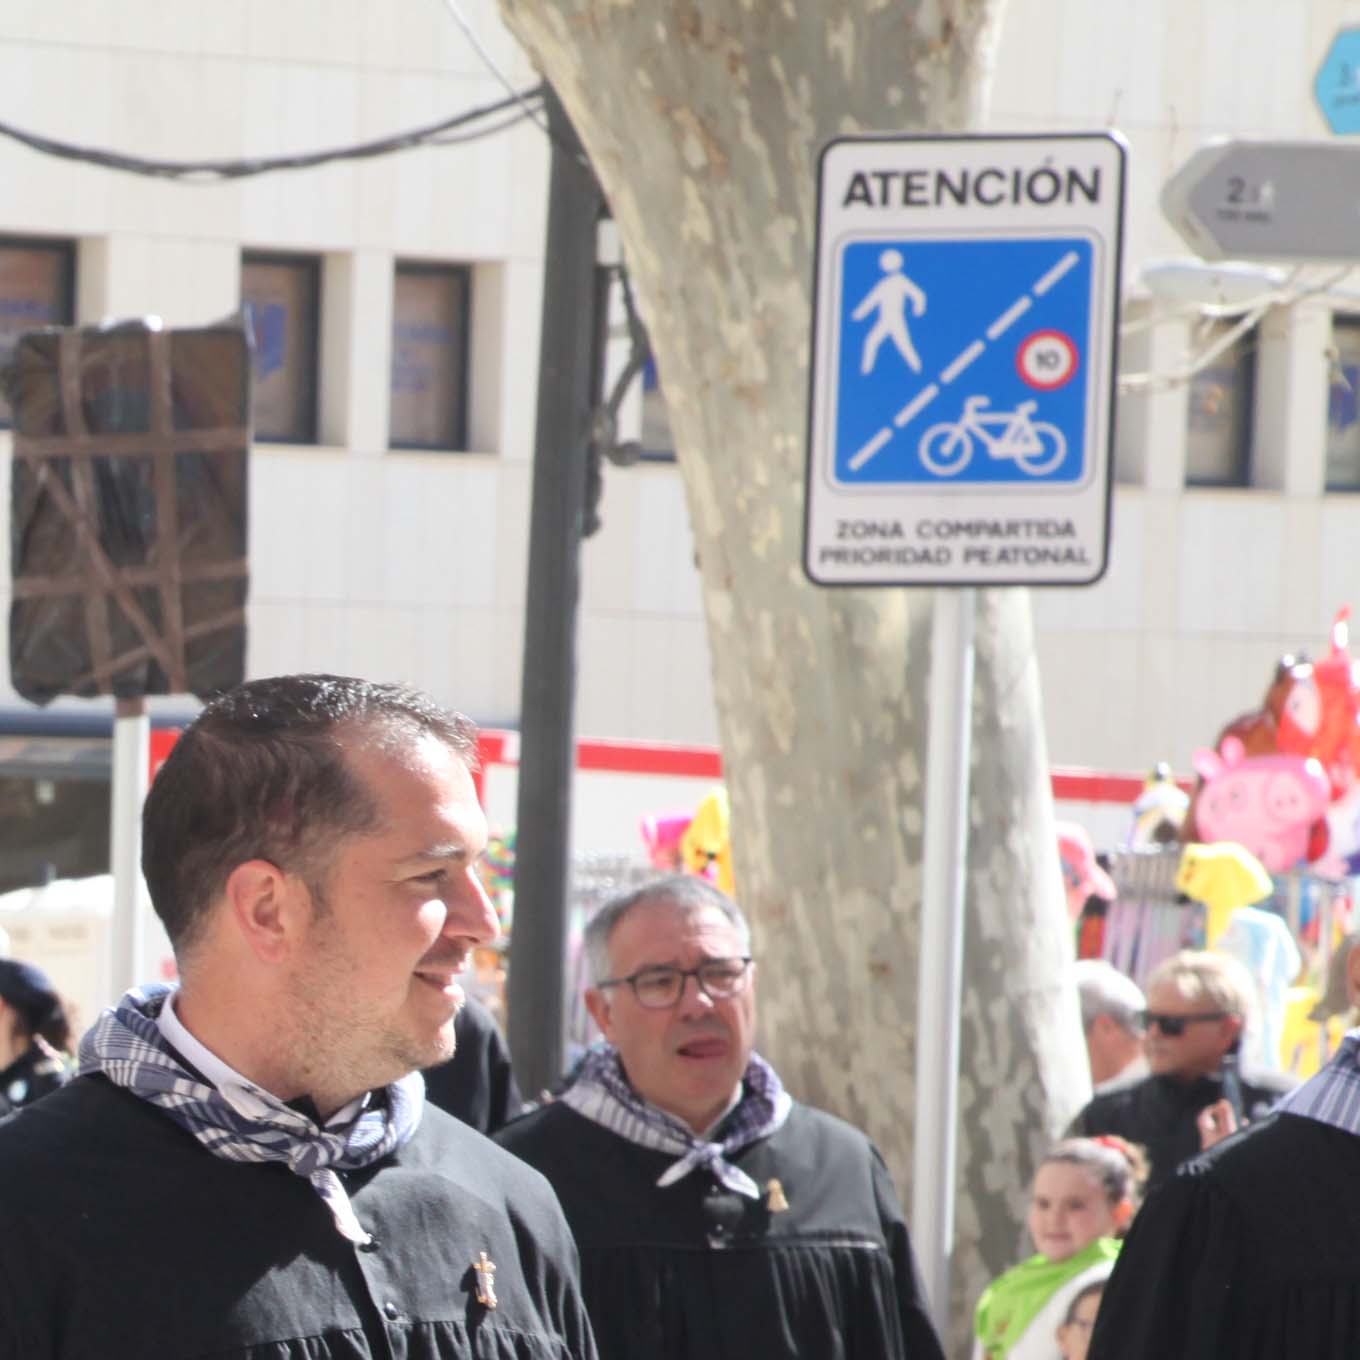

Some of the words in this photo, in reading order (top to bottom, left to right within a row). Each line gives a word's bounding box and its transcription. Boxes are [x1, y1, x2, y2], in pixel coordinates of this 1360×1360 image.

[842, 157, 1102, 209] ATENCIÓN
[1035, 348, 1061, 371] 10
[836, 519, 904, 540] ZONA
[915, 517, 1077, 540] COMPARTIDA
[819, 545, 952, 567] PRIORIDAD
[962, 545, 1091, 567] PEATONAL
